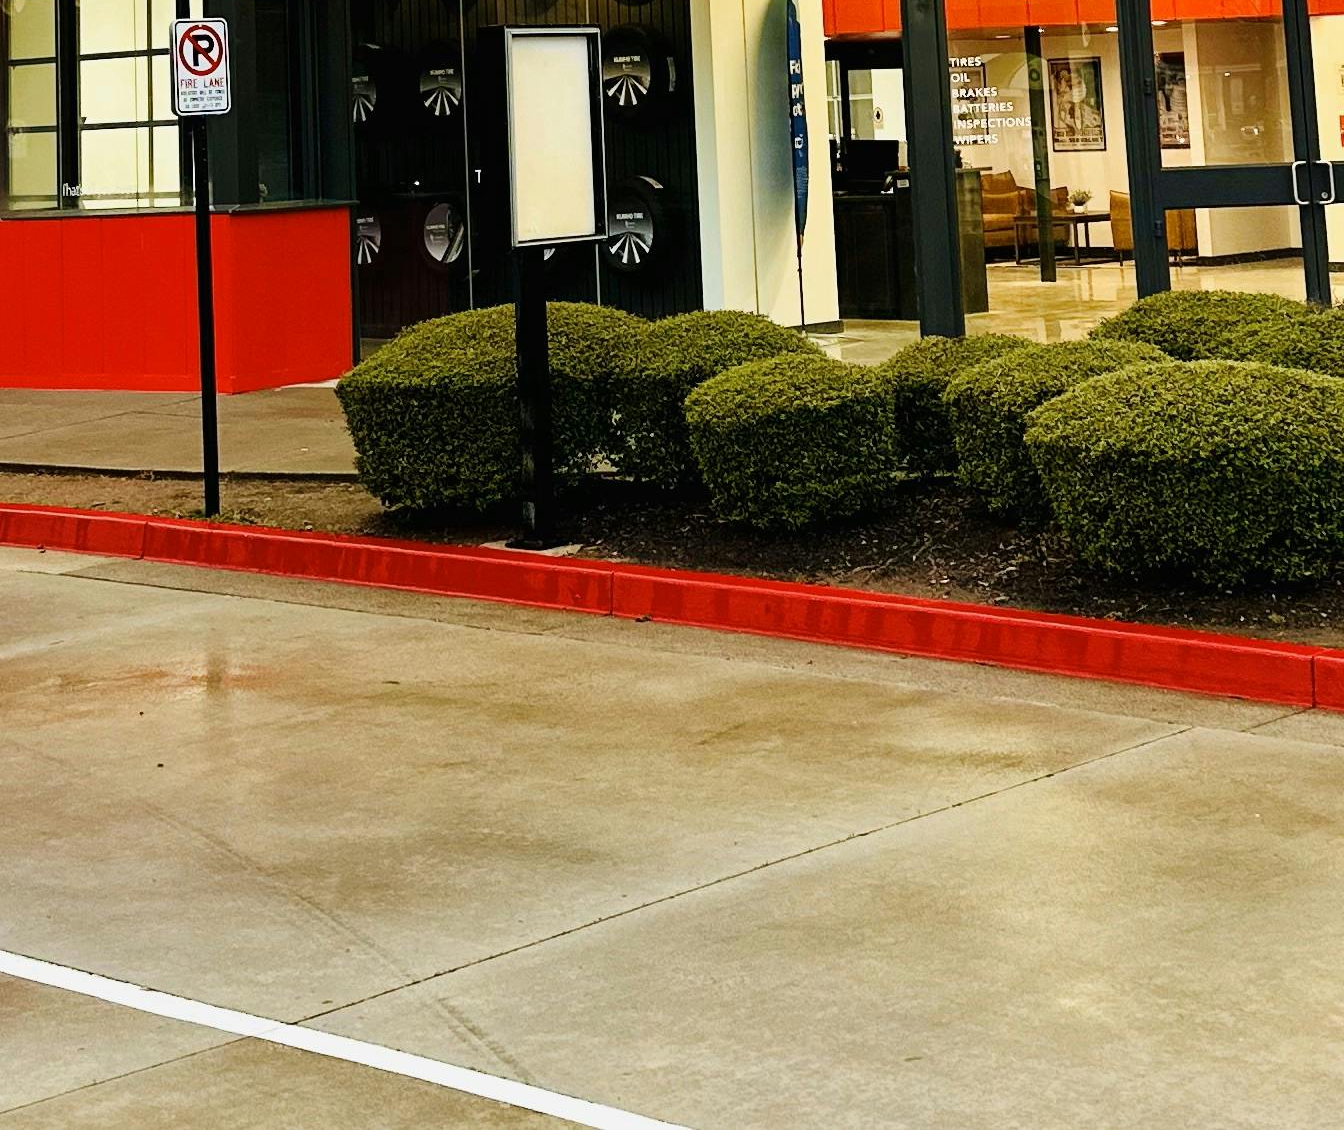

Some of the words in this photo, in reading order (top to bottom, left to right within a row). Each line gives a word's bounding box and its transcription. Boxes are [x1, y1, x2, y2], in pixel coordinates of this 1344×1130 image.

[949, 56, 983, 68] TIRES
[180, 78, 198, 88] FIRE
[203, 77, 225, 88] LANE
[950, 73, 971, 83] OIL
[951, 87, 998, 98] BRAKES
[952, 102, 1014, 114] BATTERIES
[953, 117, 1032, 129] INSPECTIONS
[954, 133, 999, 146] WIPERS
